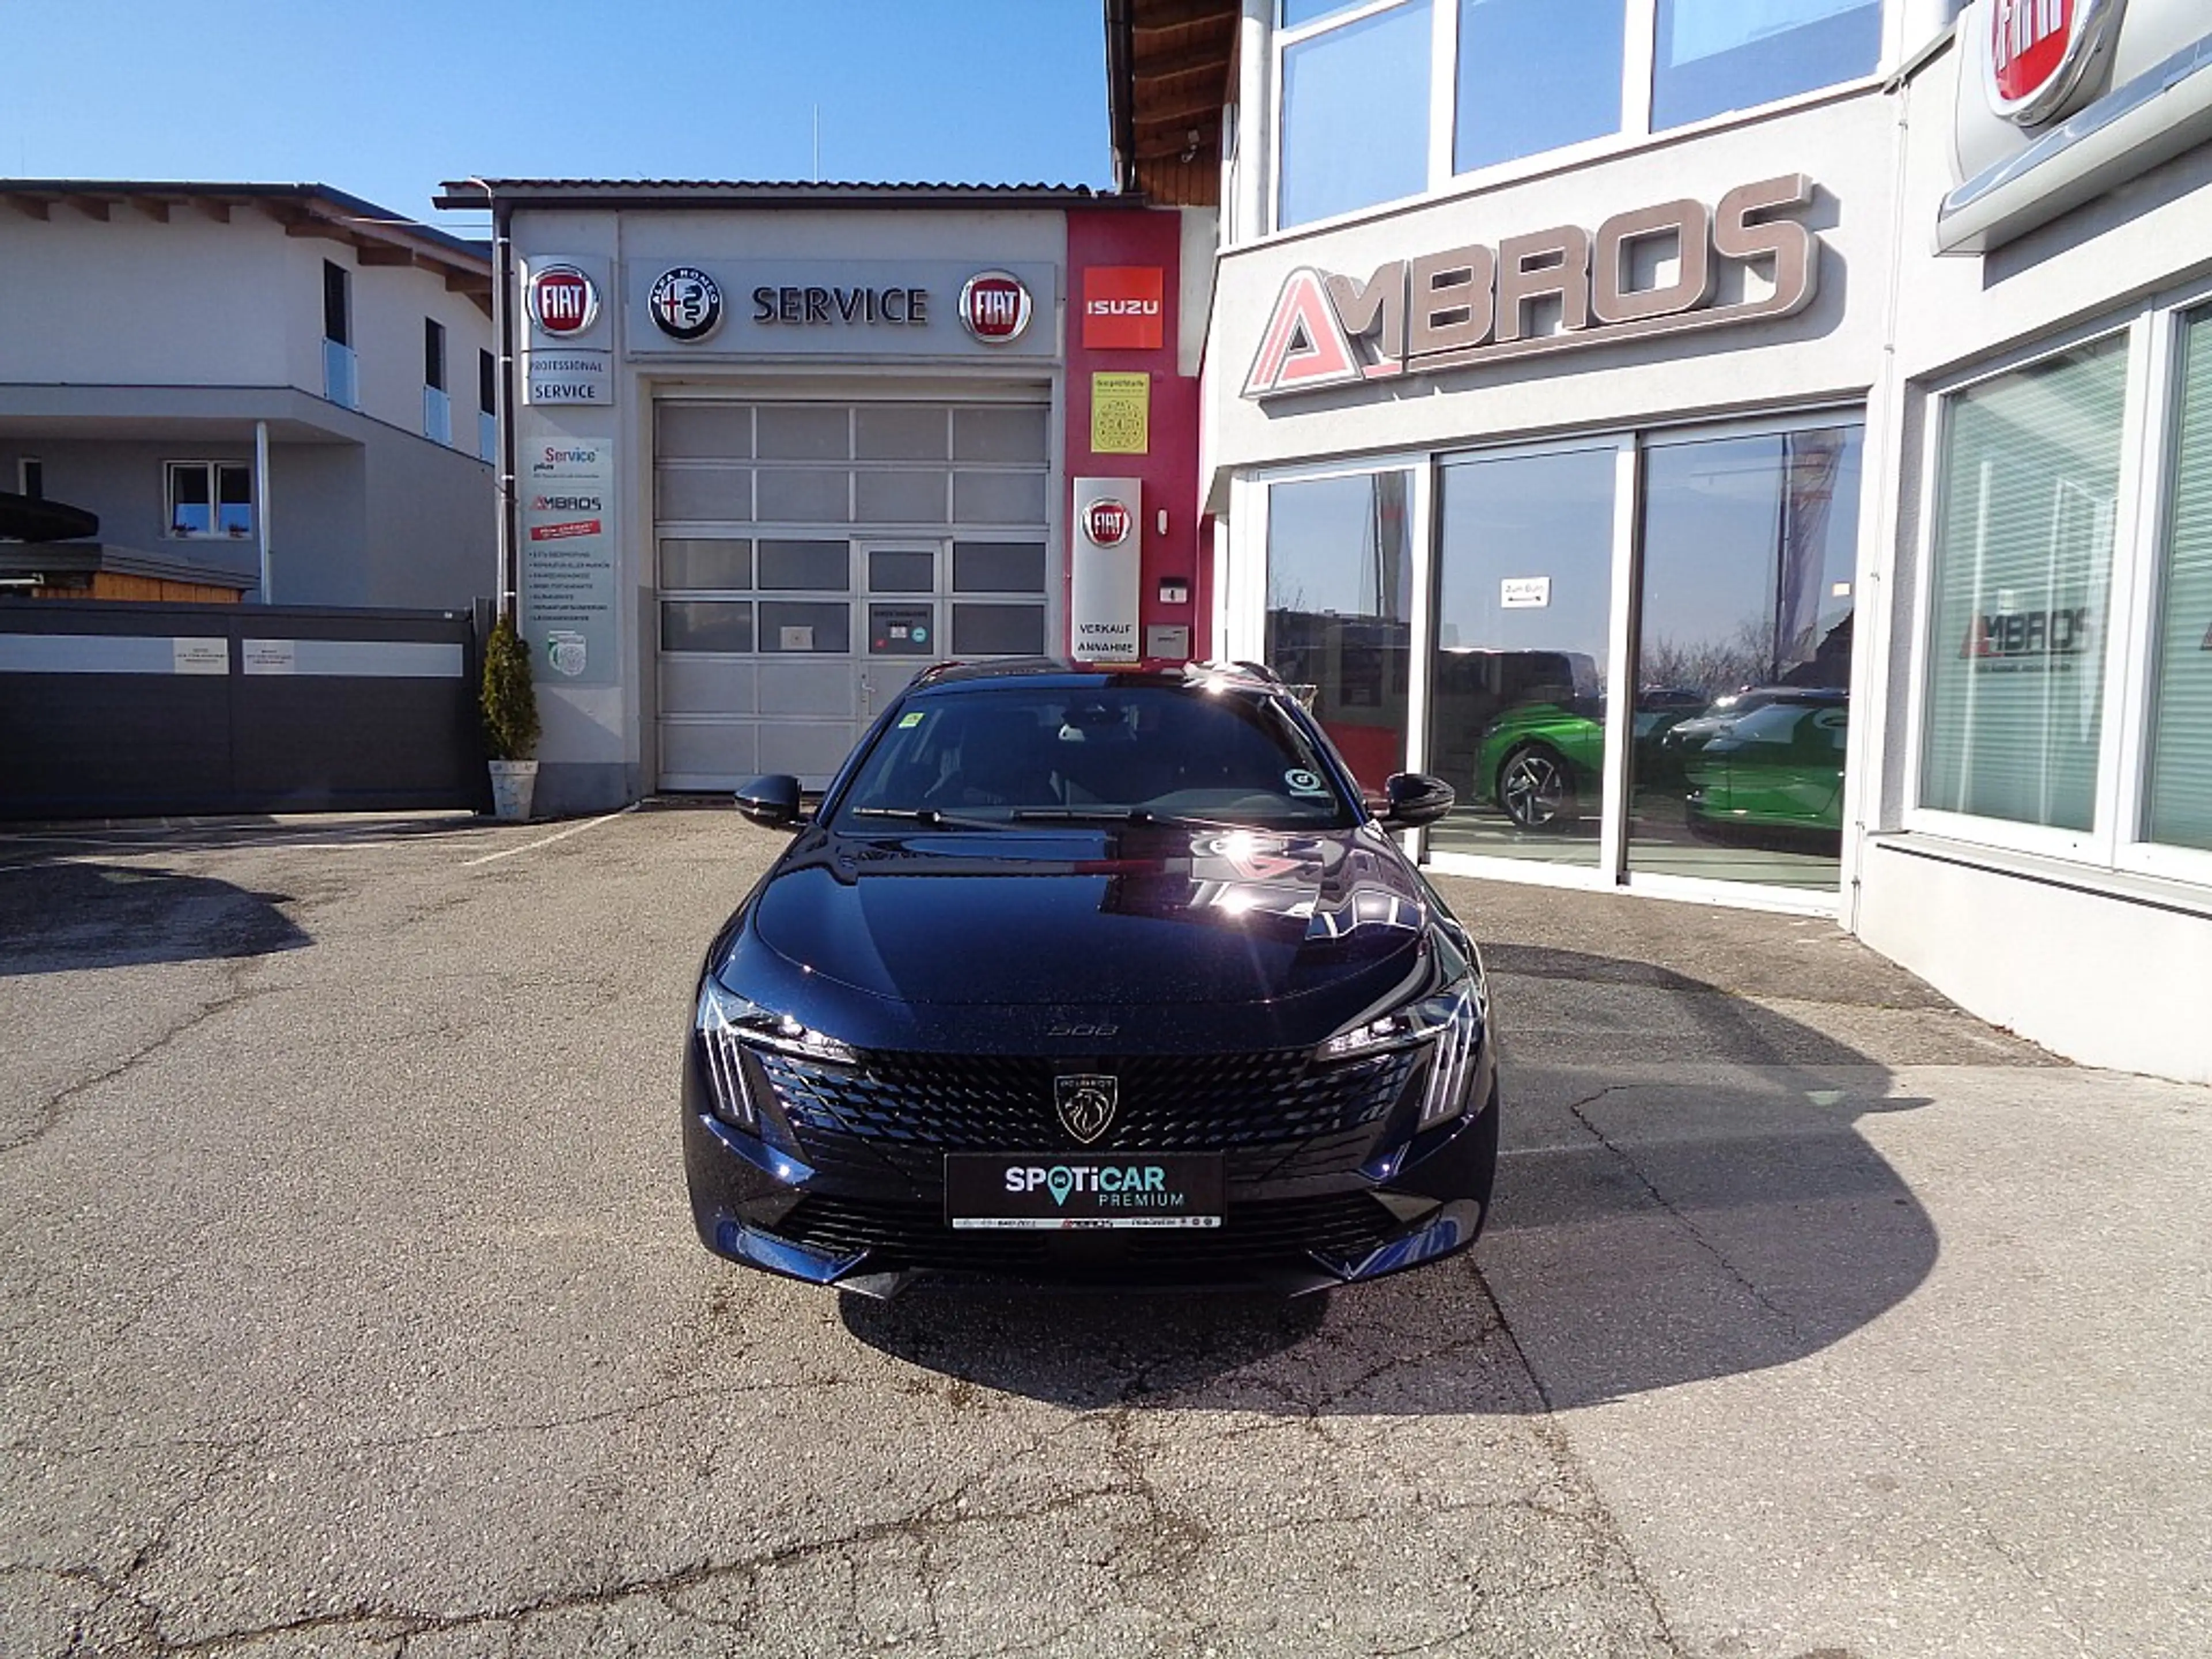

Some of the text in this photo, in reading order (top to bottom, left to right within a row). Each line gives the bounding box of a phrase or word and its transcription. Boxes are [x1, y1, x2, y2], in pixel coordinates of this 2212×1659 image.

[652, 269, 718, 304] ALFA ROMEO
[1239, 172, 1815, 399] AMBROS
[541, 285, 582, 319] FIAT
[752, 286, 928, 325] SERVICE
[976, 290, 1018, 325] FIAT
[1087, 300, 1159, 315] ISUZU
[535, 384, 596, 399] SERVICE
[545, 446, 596, 463] Service
[529, 495, 601, 511] AMBROS
[1094, 512, 1122, 535] FIAT
[1080, 624, 1132, 634] VERKAUF
[1078, 641, 1134, 653] ANNAHME
[1099, 1193, 1184, 1207] PREMIUM
